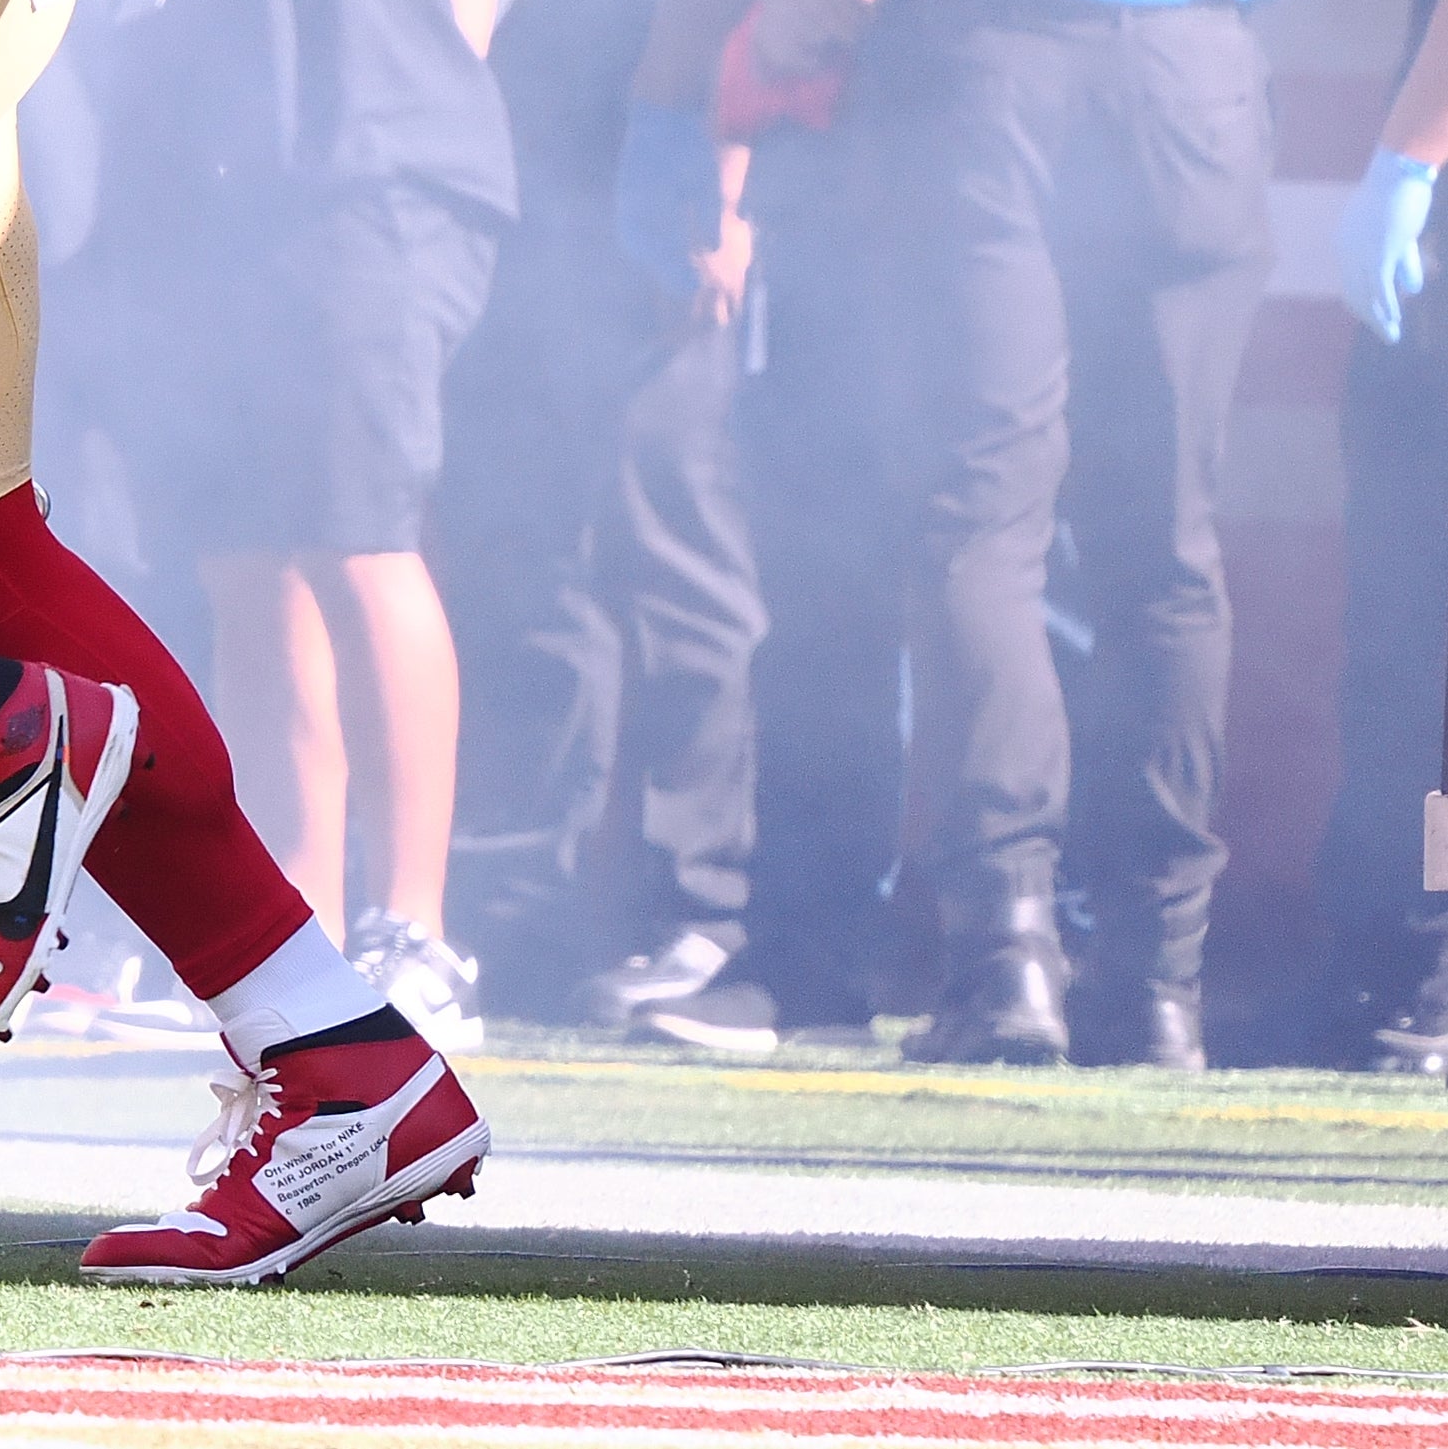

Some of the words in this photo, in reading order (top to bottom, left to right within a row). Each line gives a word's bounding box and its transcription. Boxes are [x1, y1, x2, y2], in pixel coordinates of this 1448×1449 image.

[320, 1140, 337, 1151] for
[337, 1121, 365, 1143] NIKE
[277, 1172, 335, 1203] Beaverton,
[335, 1150, 369, 1174] Oregon
[369, 1135, 388, 1152] USA
[298, 1151, 344, 1179] JORDAN
